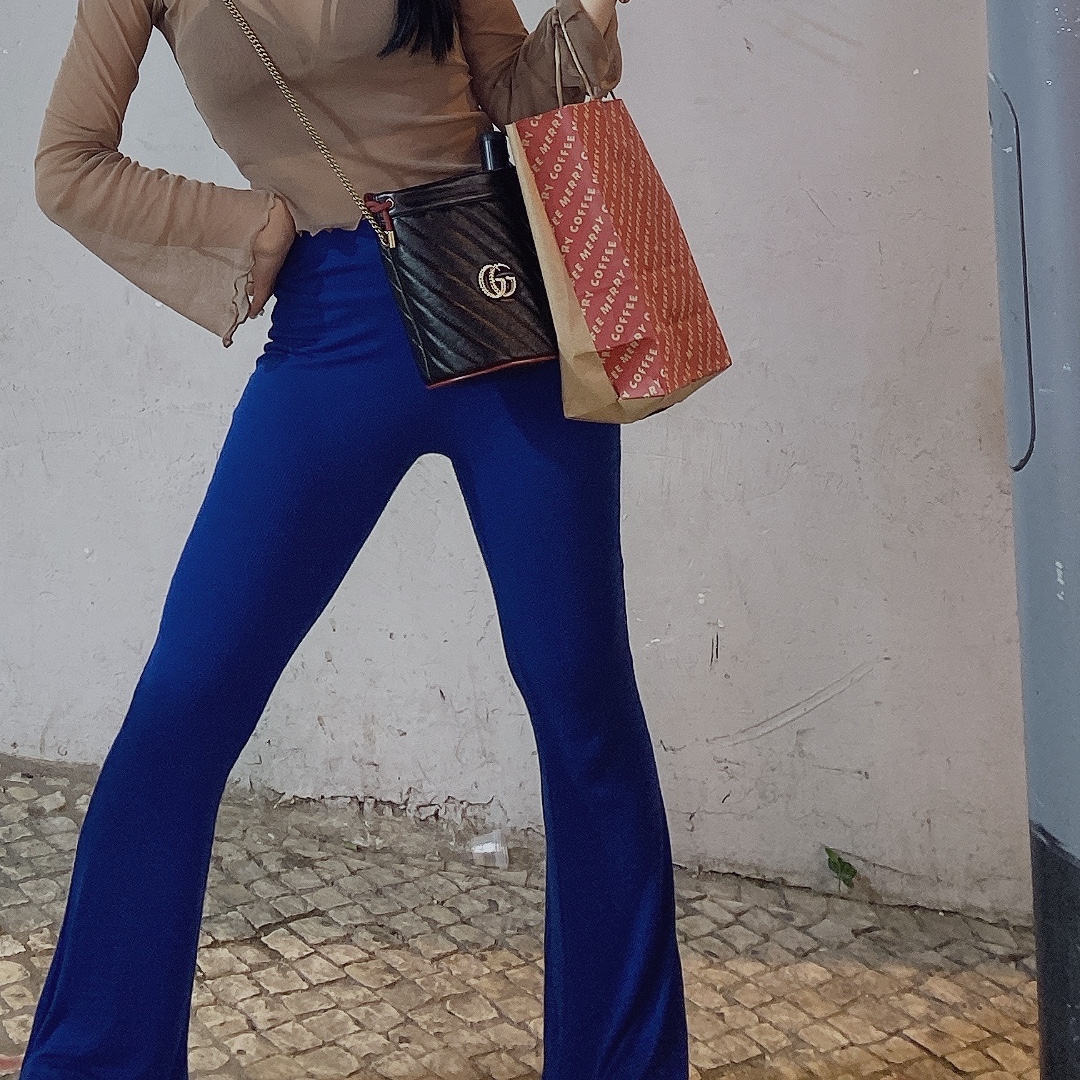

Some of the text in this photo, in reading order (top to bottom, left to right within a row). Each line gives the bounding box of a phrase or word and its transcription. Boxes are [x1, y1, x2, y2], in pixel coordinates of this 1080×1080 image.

[539, 110, 564, 156] MERRY
[549, 134, 576, 181] COFFEE
[558, 162, 585, 208] MERRY
[569, 187, 596, 234] COFFEE
[579, 215, 605, 261] MERRY
[590, 240, 617, 287] COFFEE
[600, 269, 626, 315] MERRY
[610, 294, 638, 341] COFFEE
[629, 348, 658, 389] COFFEE
